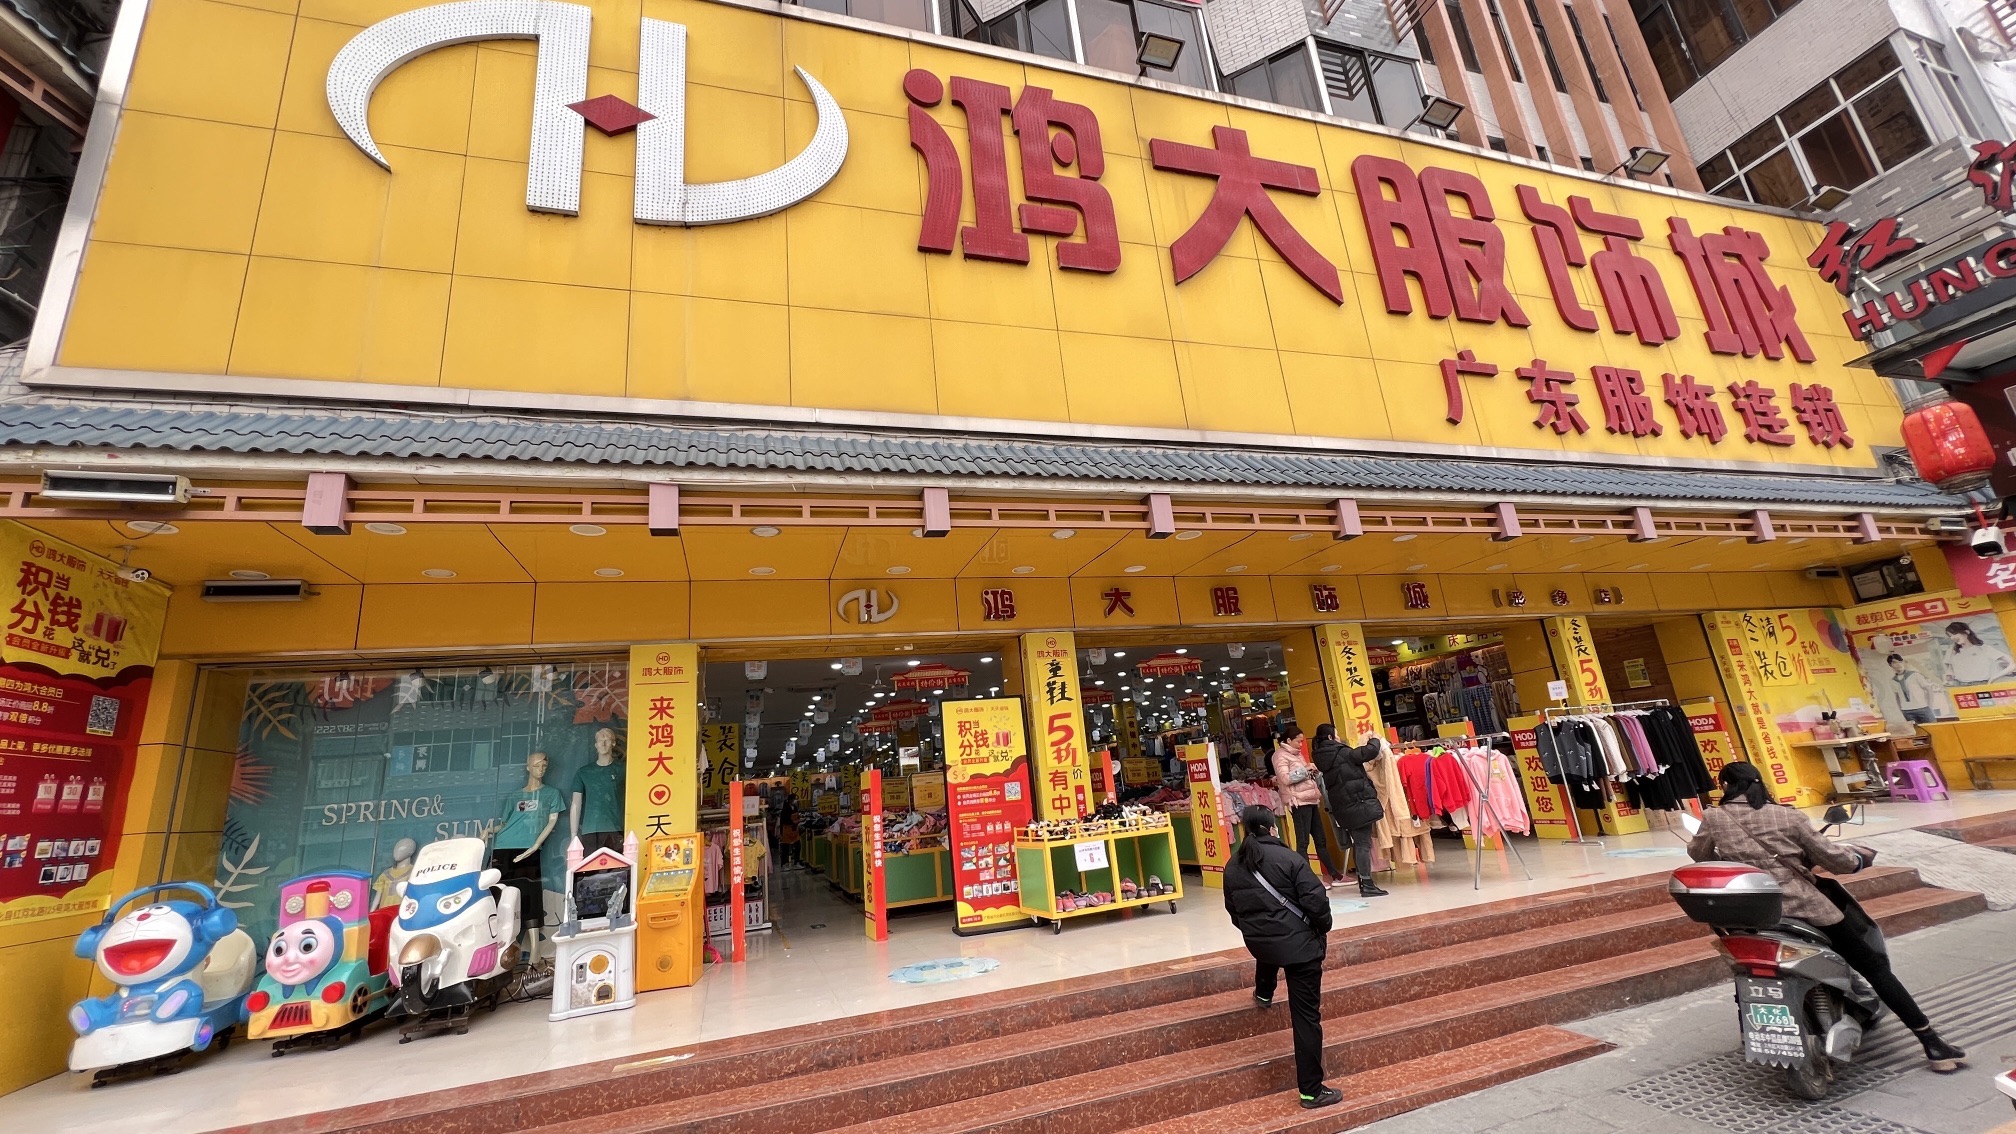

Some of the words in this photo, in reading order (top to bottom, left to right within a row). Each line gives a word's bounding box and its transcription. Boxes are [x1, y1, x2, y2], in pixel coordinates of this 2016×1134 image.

[903, 68, 1816, 364] 鸿大服饰城
[1439, 349, 1854, 449] 广东服饰连锁
[983, 581, 1431, 622] 鸿大服饰城
[1856, 609, 1900, 626] 裁剪区
[1037, 650, 1068, 658] 鸿大服饰
[1568, 618, 1590, 657] 冬装
[642, 666, 684, 676] 鸿大服饰
[1044, 659, 1075, 706] 童鞋
[1340, 645, 1365, 689] 冬装
[1689, 717, 1716, 726] HODA
[1190, 763, 1207, 772] HODA
[1525, 755, 1554, 813] 欢迎您
[872, 815, 883, 867] 祝您生活愉快
[1197, 790, 1217, 858] 欢迎您
[416, 864, 457, 877] POLICE
[1757, 1014, 1789, 1025] 11268
